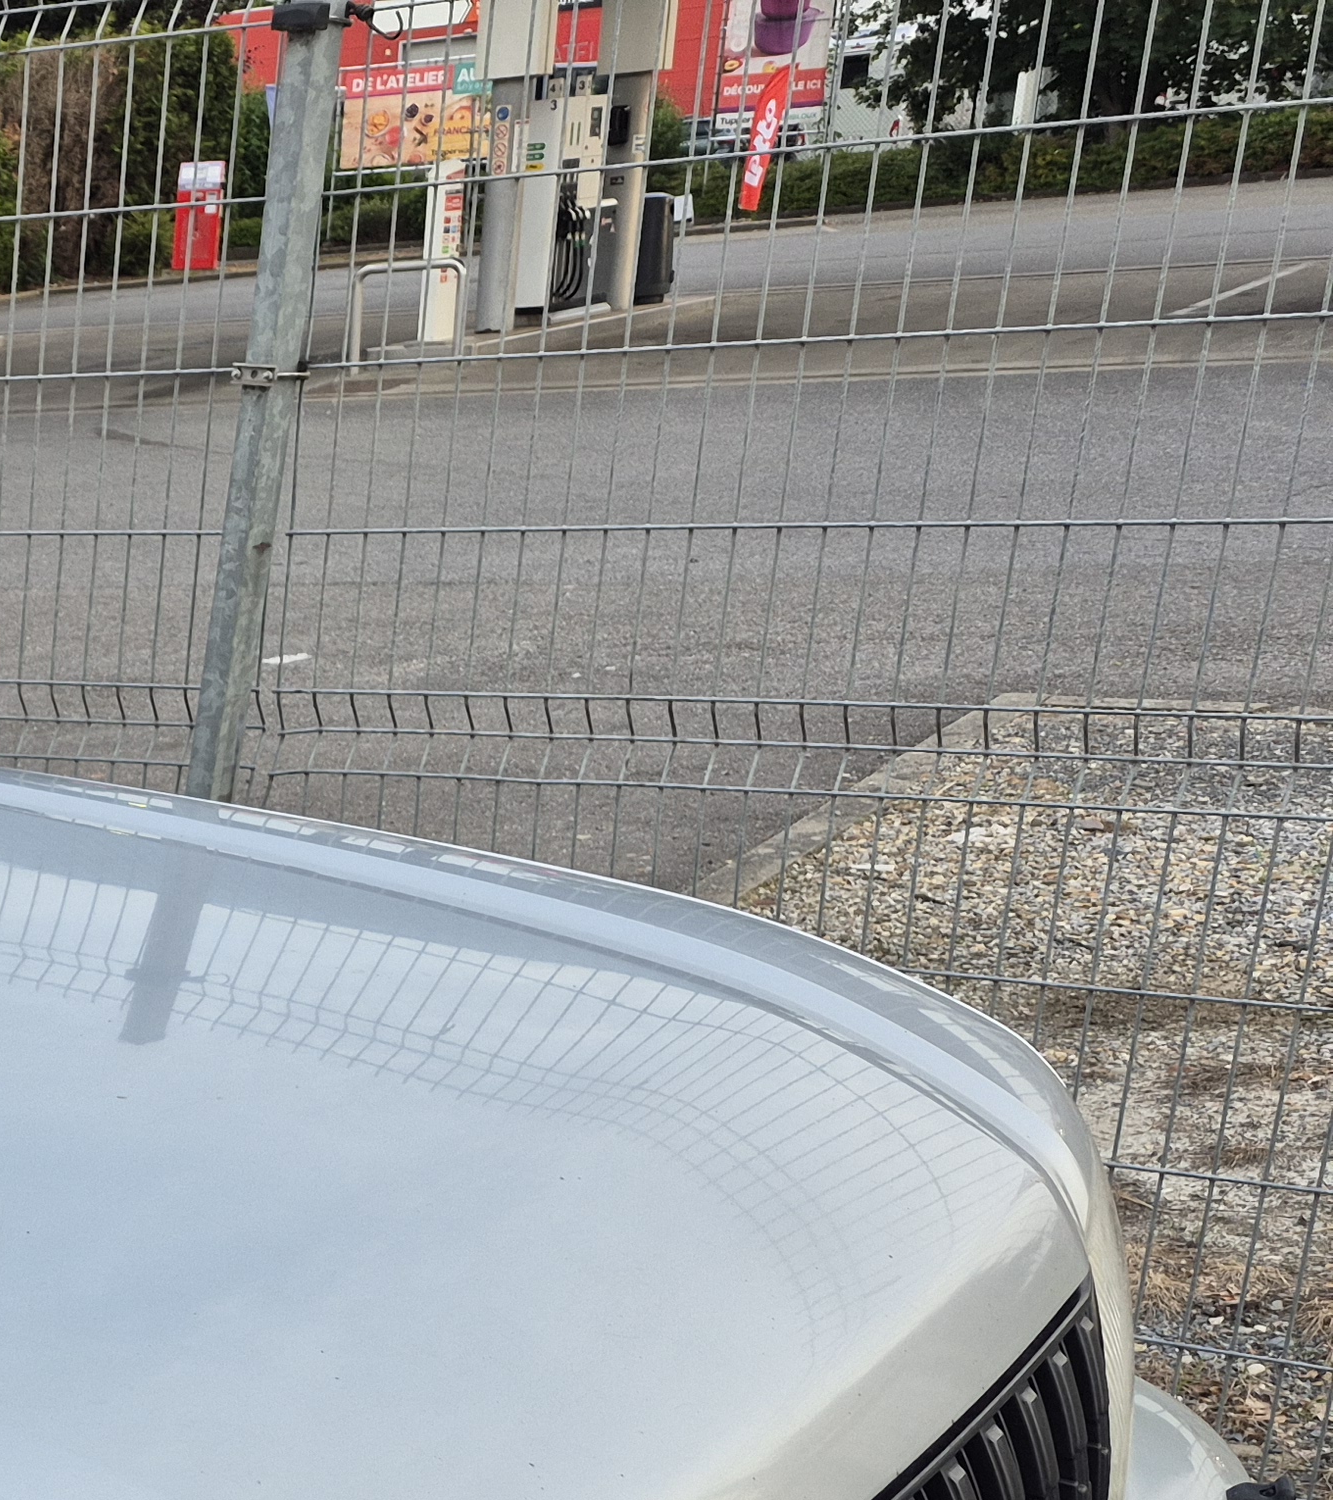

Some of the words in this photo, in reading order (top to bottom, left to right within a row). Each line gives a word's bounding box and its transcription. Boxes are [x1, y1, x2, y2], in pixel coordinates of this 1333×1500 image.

[352, 77, 374, 92] DE
[807, 79, 821, 89] ICI
[550, 100, 558, 111] 3
